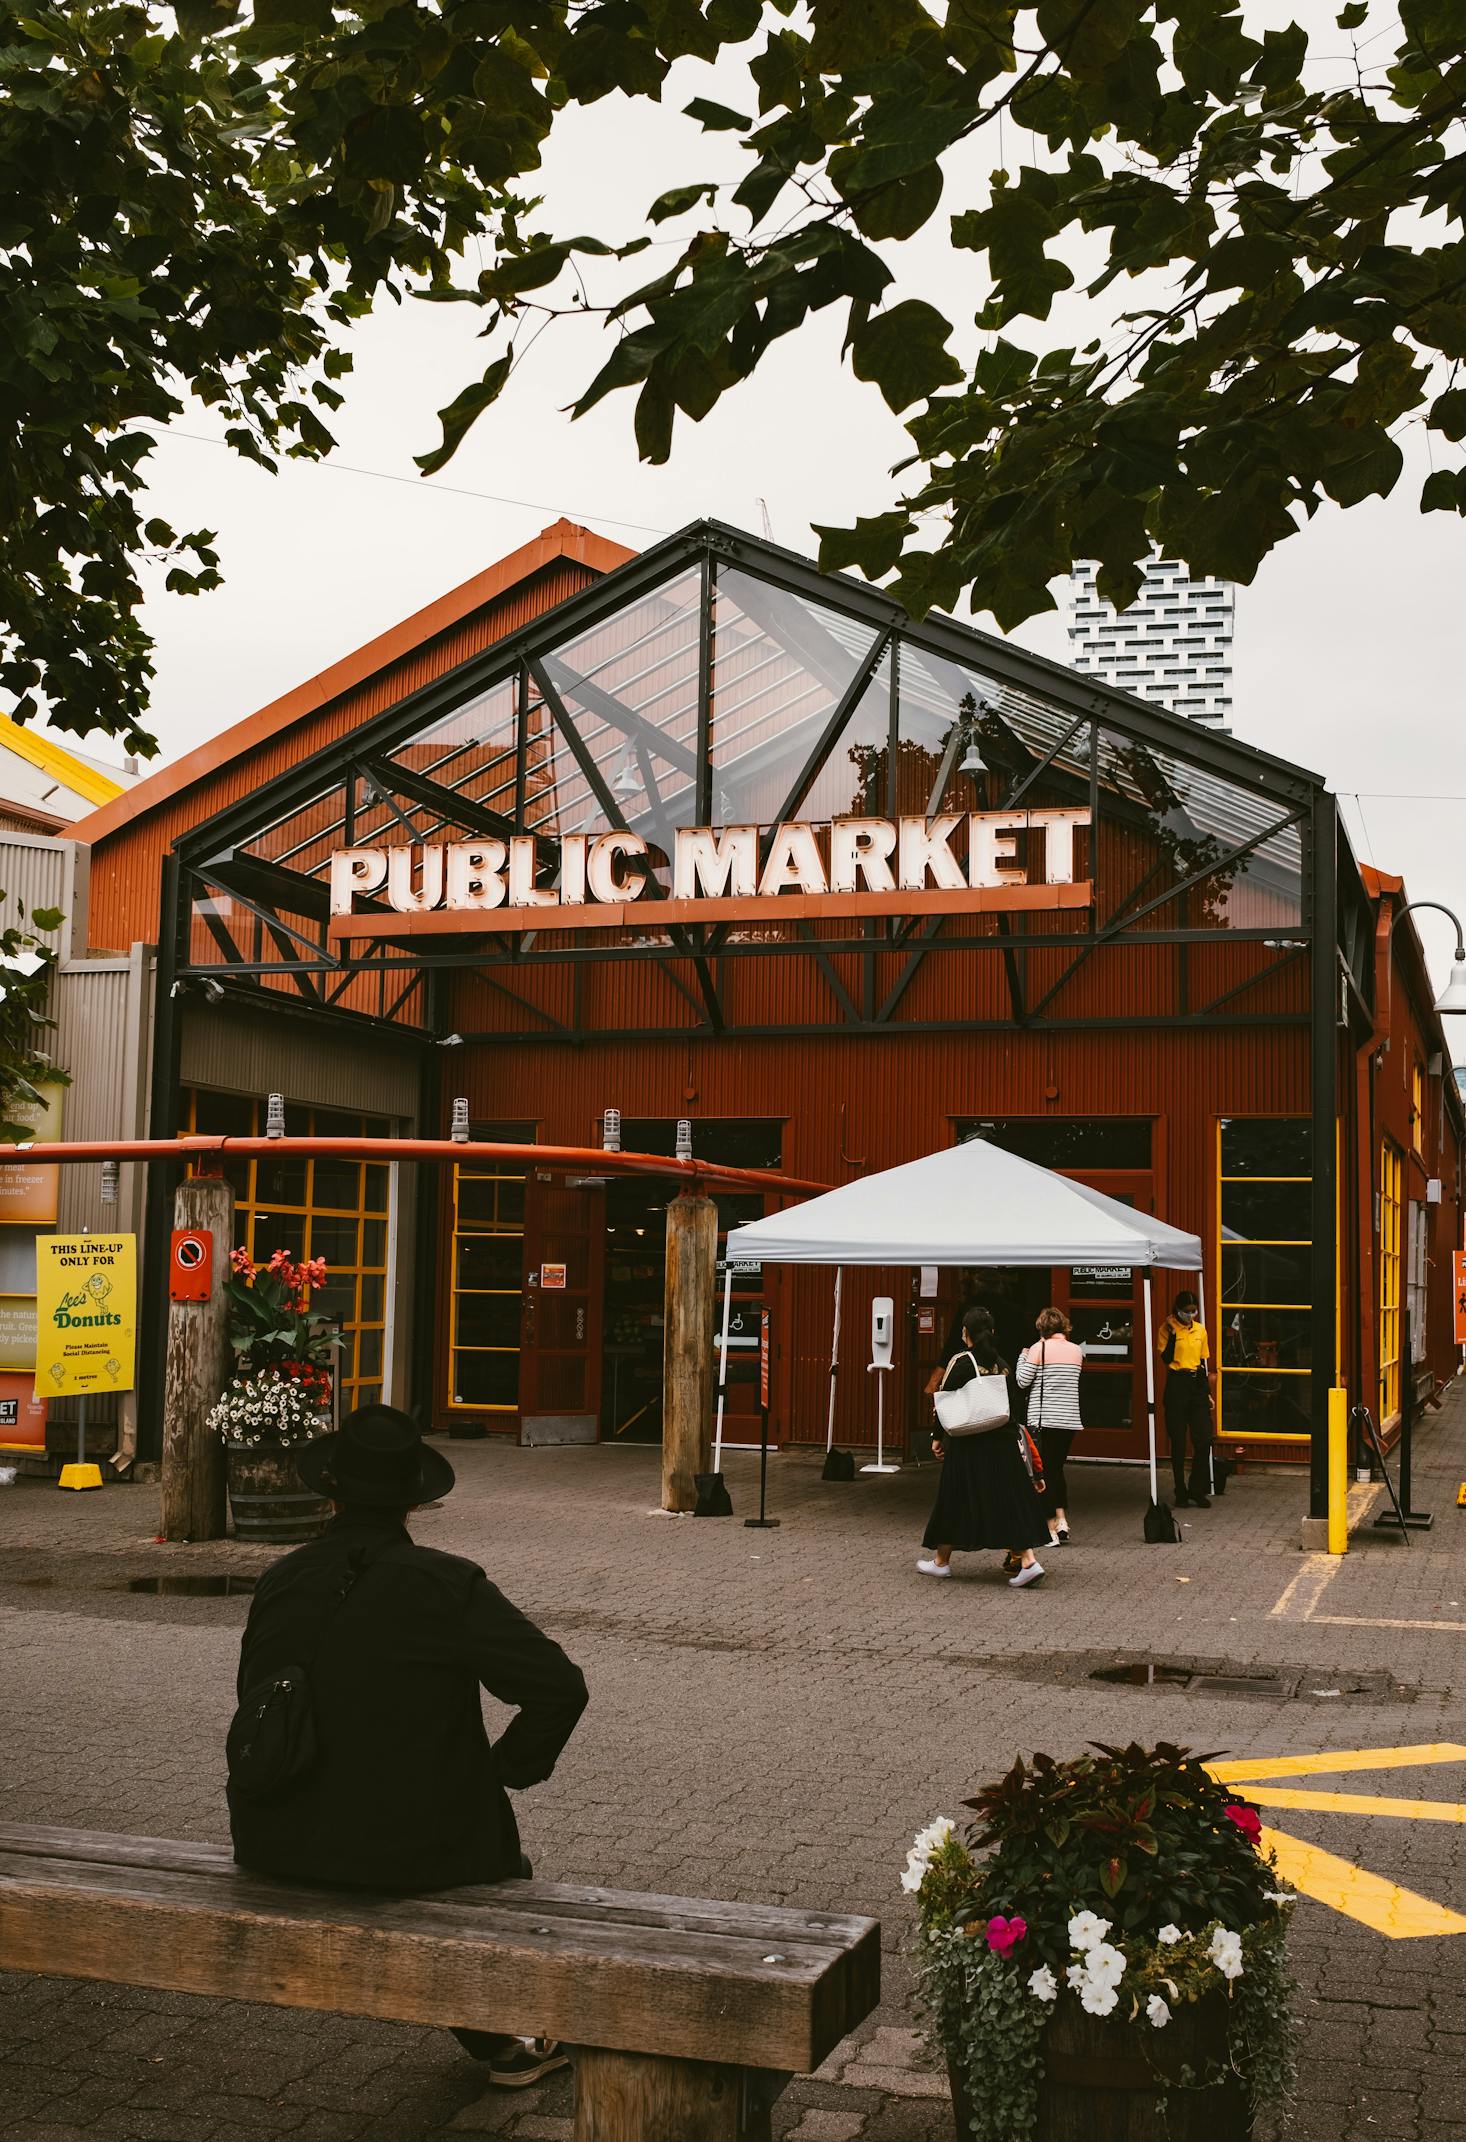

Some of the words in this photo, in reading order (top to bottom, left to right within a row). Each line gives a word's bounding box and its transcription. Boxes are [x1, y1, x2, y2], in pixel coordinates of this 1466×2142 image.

[330, 829, 648, 916] PUBLIC
[674, 806, 1092, 900] MARKET
[15, 1174, 44, 1184] freezer
[51, 1245, 77, 1254] THIS
[80, 1244, 123, 1254] LINE-UP
[60, 1257, 90, 1266] ONLY
[93, 1256, 115, 1265] FOR
[55, 1292, 87, 1313] Lee's
[53, 1312, 122, 1328] Donuts
